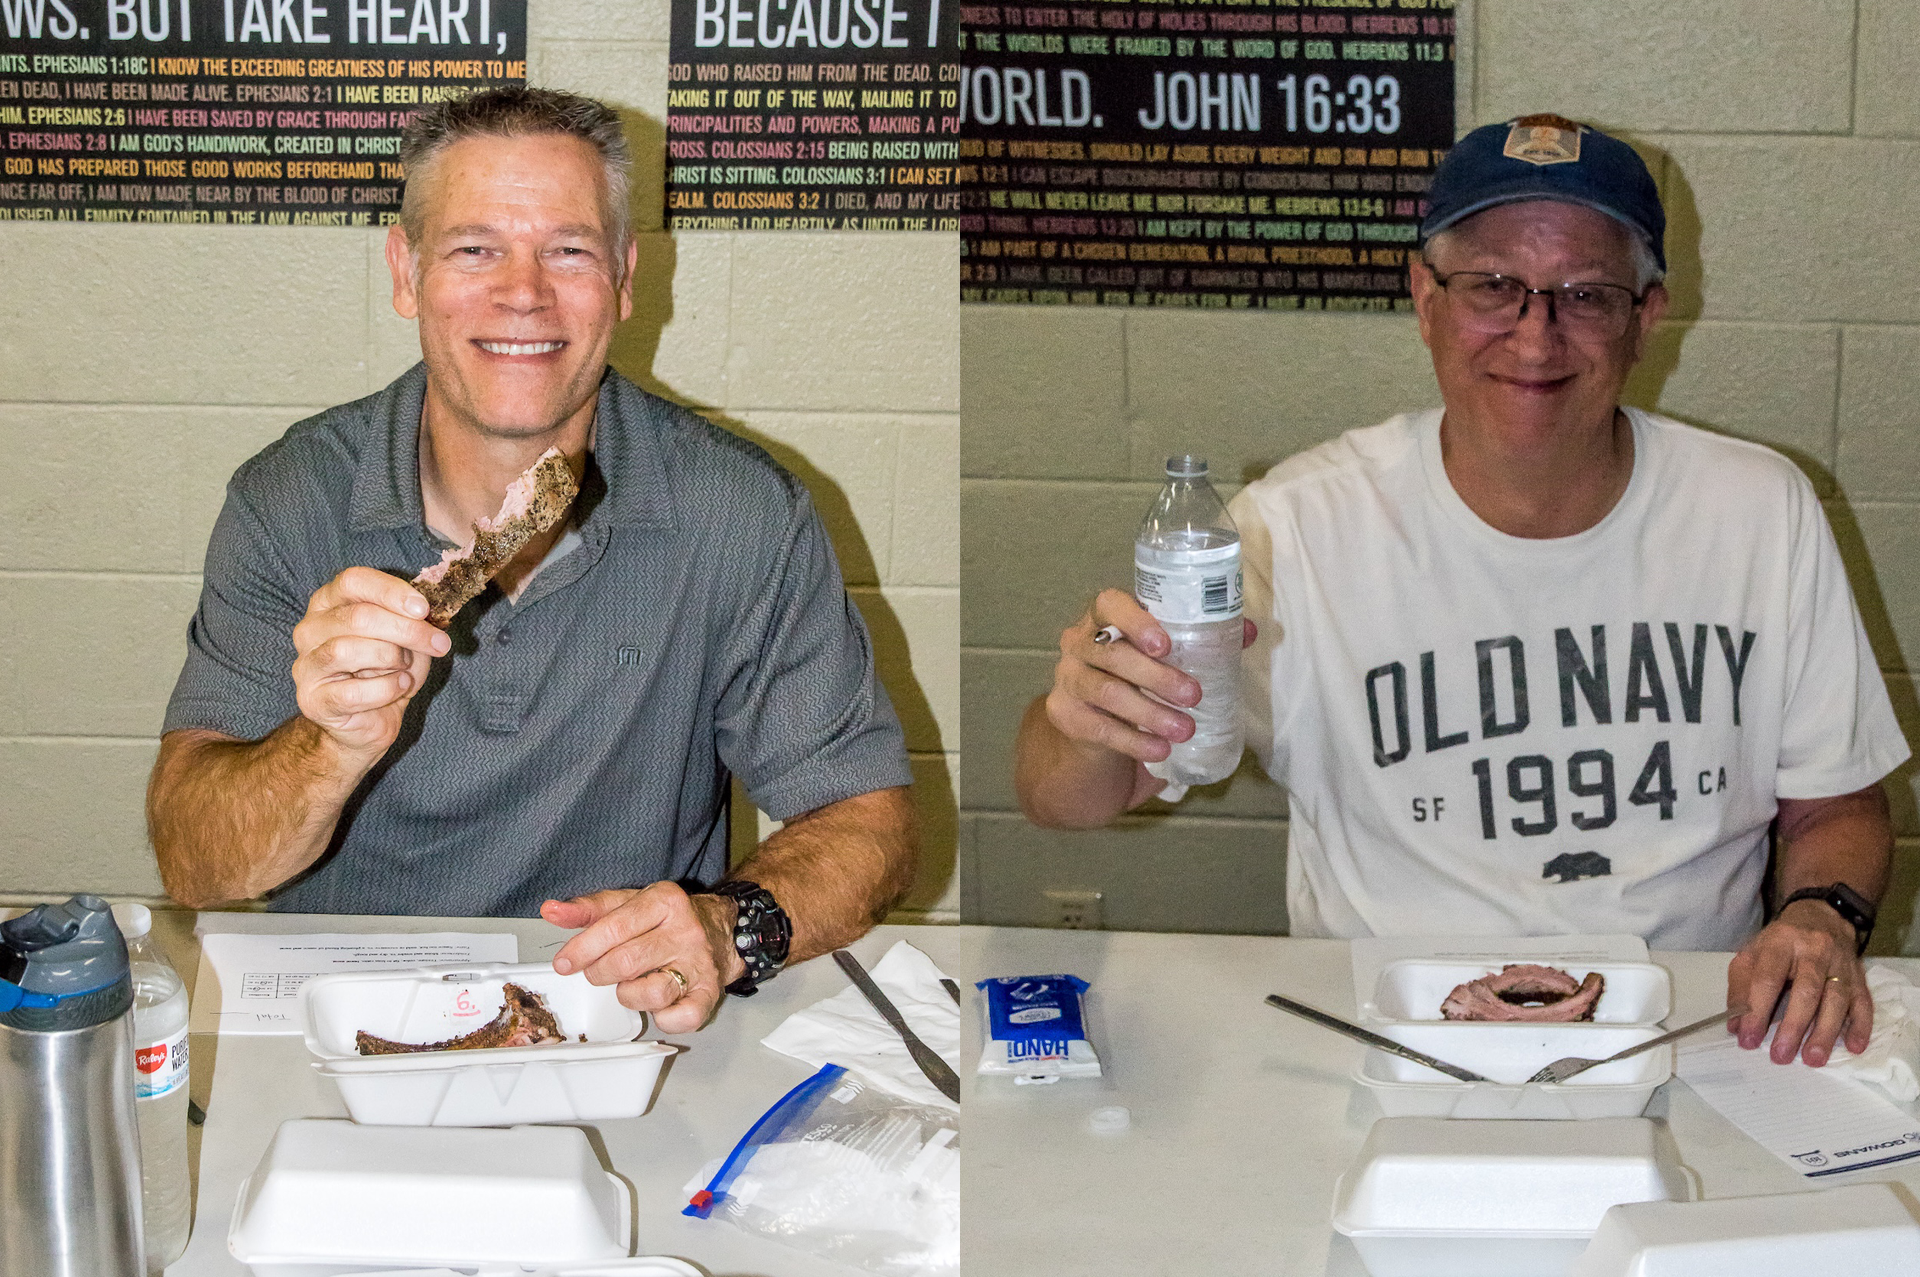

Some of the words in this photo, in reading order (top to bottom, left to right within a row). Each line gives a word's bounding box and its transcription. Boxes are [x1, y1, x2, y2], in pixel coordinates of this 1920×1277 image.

[695, 0, 909, 48] BECAUSE
[975, 33, 1000, 51] THE
[1005, 34, 1064, 53] WORLDS
[1069, 36, 1109, 54] WERE
[1115, 37, 1171, 56] FRAMED
[1176, 39, 1195, 57] BY
[1202, 40, 1227, 57] THE
[1233, 40, 1275, 58] WORD
[1280, 41, 1298, 59] OF
[1305, 42, 1336, 60] GOD.
[1342, 42, 1409, 61] HEBREWS
[1415, 43, 1444, 61] 11:3
[34, 55, 107, 74] EPHESIANS
[111, 57, 147, 75] 1:18C
[158, 58, 199, 75] KNOW
[203, 59, 227, 76] THE
[231, 59, 304, 77] EXCEEDING
[308, 60, 385, 77] GREATNESS
[388, 60, 405, 77] OF
[408, 60, 431, 78] HIS
[434, 60, 482, 78] POWER
[485, 61, 503, 78] TO
[506, 61, 526, 78] ME
[697, 64, 728, 82] WHO
[734, 64, 781, 82] RAISED
[787, 64, 813, 82] HIM
[818, 64, 857, 82] FROM
[863, 64, 889, 82] THE
[894, 64, 933, 82] DEAD.
[23, 81, 61, 101] DEAD,
[74, 82, 108, 99] HAVE
[112, 83, 147, 100] BEEN
[151, 83, 189, 101] MADE
[193, 84, 232, 102] ALIVE.
[237, 85, 309, 102] EPHESIANS
[313, 86, 332, 102] 2:1
[346, 86, 380, 103] HAVE
[384, 86, 418, 103] BEEN
[716, 90, 728, 108] IT
[734, 90, 760, 108] OUT
[767, 90, 785, 108] OF
[791, 90, 816, 108] THE
[823, 90, 855, 110] WAY,
[861, 90, 913, 108] NAILING
[920, 90, 933, 108] IT
[939, 90, 956, 108] TO
[960, 66, 1104, 128] ORLD.
[1138, 71, 1261, 131] JOHN
[1277, 74, 1400, 134] 16:33
[28, 107, 102, 126] EPHESIANS
[104, 108, 125, 126] 2:6
[136, 109, 169, 127] HAVE
[173, 109, 207, 127] BEEN
[210, 110, 252, 128] SAVED
[256, 110, 274, 128] BY
[277, 111, 321, 128] GRACE
[325, 111, 387, 128] THROUGH
[768, 116, 795, 134] AND
[801, 116, 862, 134] POWERS,
[868, 116, 919, 134] MAKING
[926, 116, 935, 134] A
[9, 133, 82, 150] EPHESIANS
[86, 134, 107, 151] 2:8
[119, 134, 140, 151] AM
[143, 134, 183, 152] GOD'S
[187, 135, 271, 155] HANDIWORK,
[274, 136, 333, 154] CREATED
[337, 136, 351, 154] IN
[357, 136, 402, 154] CHRIST
[712, 142, 792, 159] COLOSSIANS
[796, 142, 825, 159] 2:15
[828, 142, 868, 159] BEING
[872, 142, 920, 159] RAISED
[924, 142, 958, 159] WITH
[5, 158, 32, 175] GOD
[38, 158, 64, 175] HAS
[69, 159, 139, 177] PREPARED
[143, 159, 186, 177] THOSE
[192, 160, 228, 178] GOOD
[233, 160, 282, 178] WORKS
[287, 161, 374, 179] BEFOREHAND
[710, 167, 722, 184] IS
[726, 167, 779, 184] SITTING.
[782, 167, 863, 184] COLOSSIANS
[866, 167, 885, 184] 3:1
[897, 167, 923, 184] CAN
[926, 167, 952, 184] SET
[30, 183, 55, 200] FAR
[58, 184, 86, 202] OFF,
[97, 184, 117, 201] AM
[120, 185, 152, 201] NOW
[155, 185, 192, 202] MADE
[197, 186, 230, 202] NEAR
[234, 186, 251, 202] BY
[255, 186, 280, 203] THE
[284, 186, 328, 203] BLOOD
[331, 186, 348, 203] OF
[713, 192, 794, 210] COLOSSIANS
[799, 192, 819, 210] 3:2
[835, 192, 869, 210] DIED,
[875, 192, 902, 210] AND
[907, 192, 928, 210] MY
[934, 192, 960, 210] LIFE
[1365, 635, 1530, 768] OLD
[1554, 622, 1757, 728] NAVY
[1412, 797, 1445, 822] SF
[1472, 740, 1677, 840] 1994
[1698, 766, 1727, 796] CA
[1013, 1038, 1069, 1057] HAND
[1834, 1139, 1906, 1158] GOWANS
